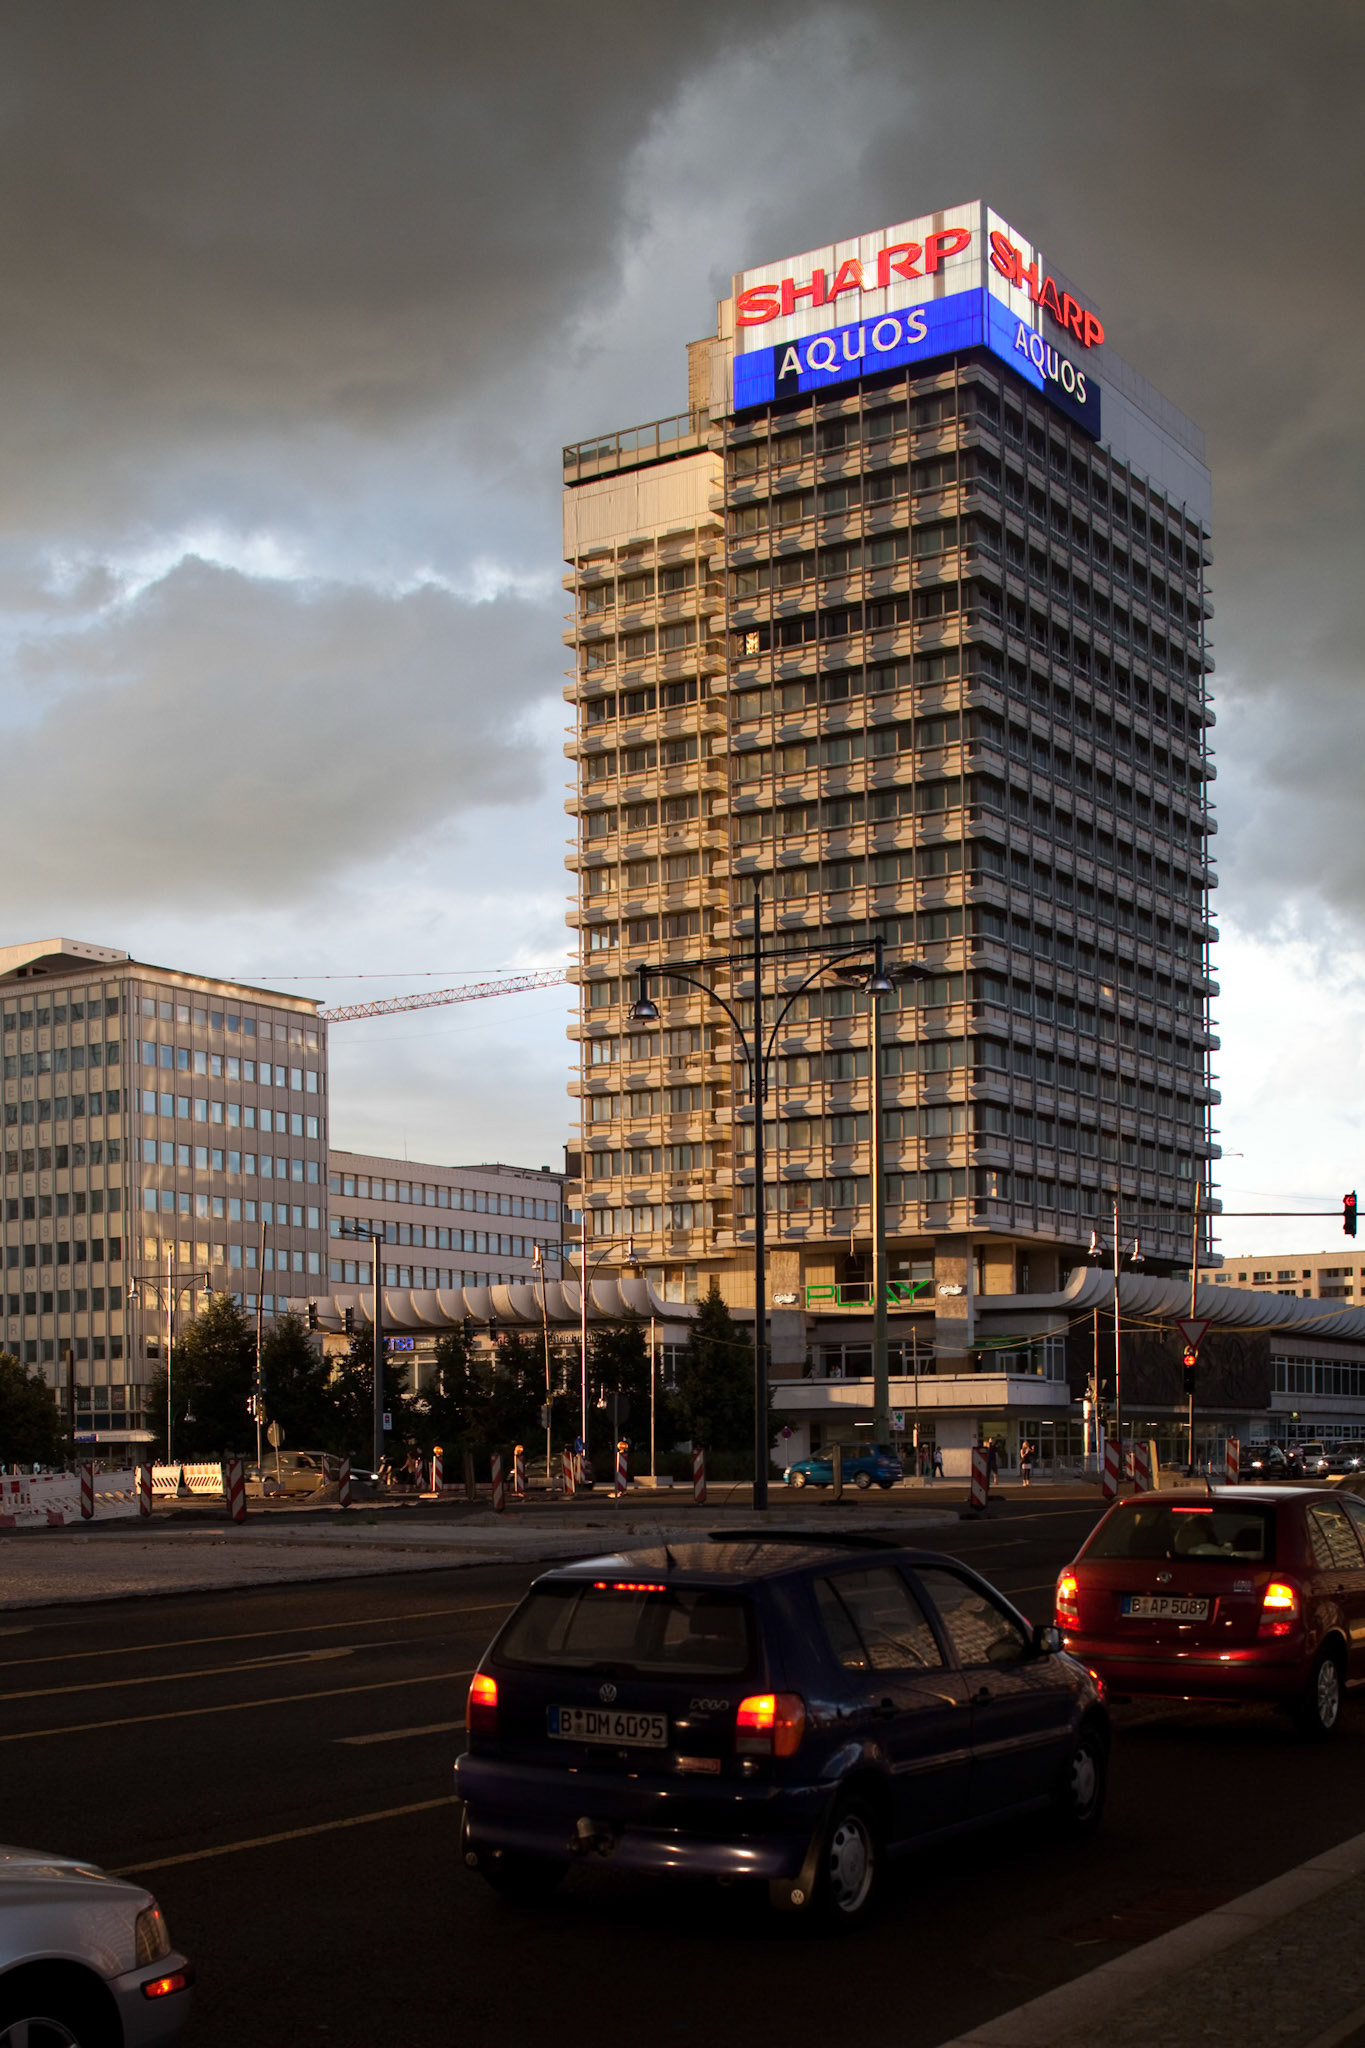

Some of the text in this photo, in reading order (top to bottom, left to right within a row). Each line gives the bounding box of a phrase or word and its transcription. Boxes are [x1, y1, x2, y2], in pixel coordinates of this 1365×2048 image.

[736, 228, 971, 326] SHARP
[990, 230, 1105, 348] SHARP
[778, 309, 928, 380] AQUOS
[1015, 322, 1087, 404] AQUOS
[26, 1271, 85, 1287] NOCH
[807, 1280, 928, 1308] PLAY
[1132, 1598, 1207, 1615] B AP 5089
[561, 1711, 663, 1740] B DM 6095
